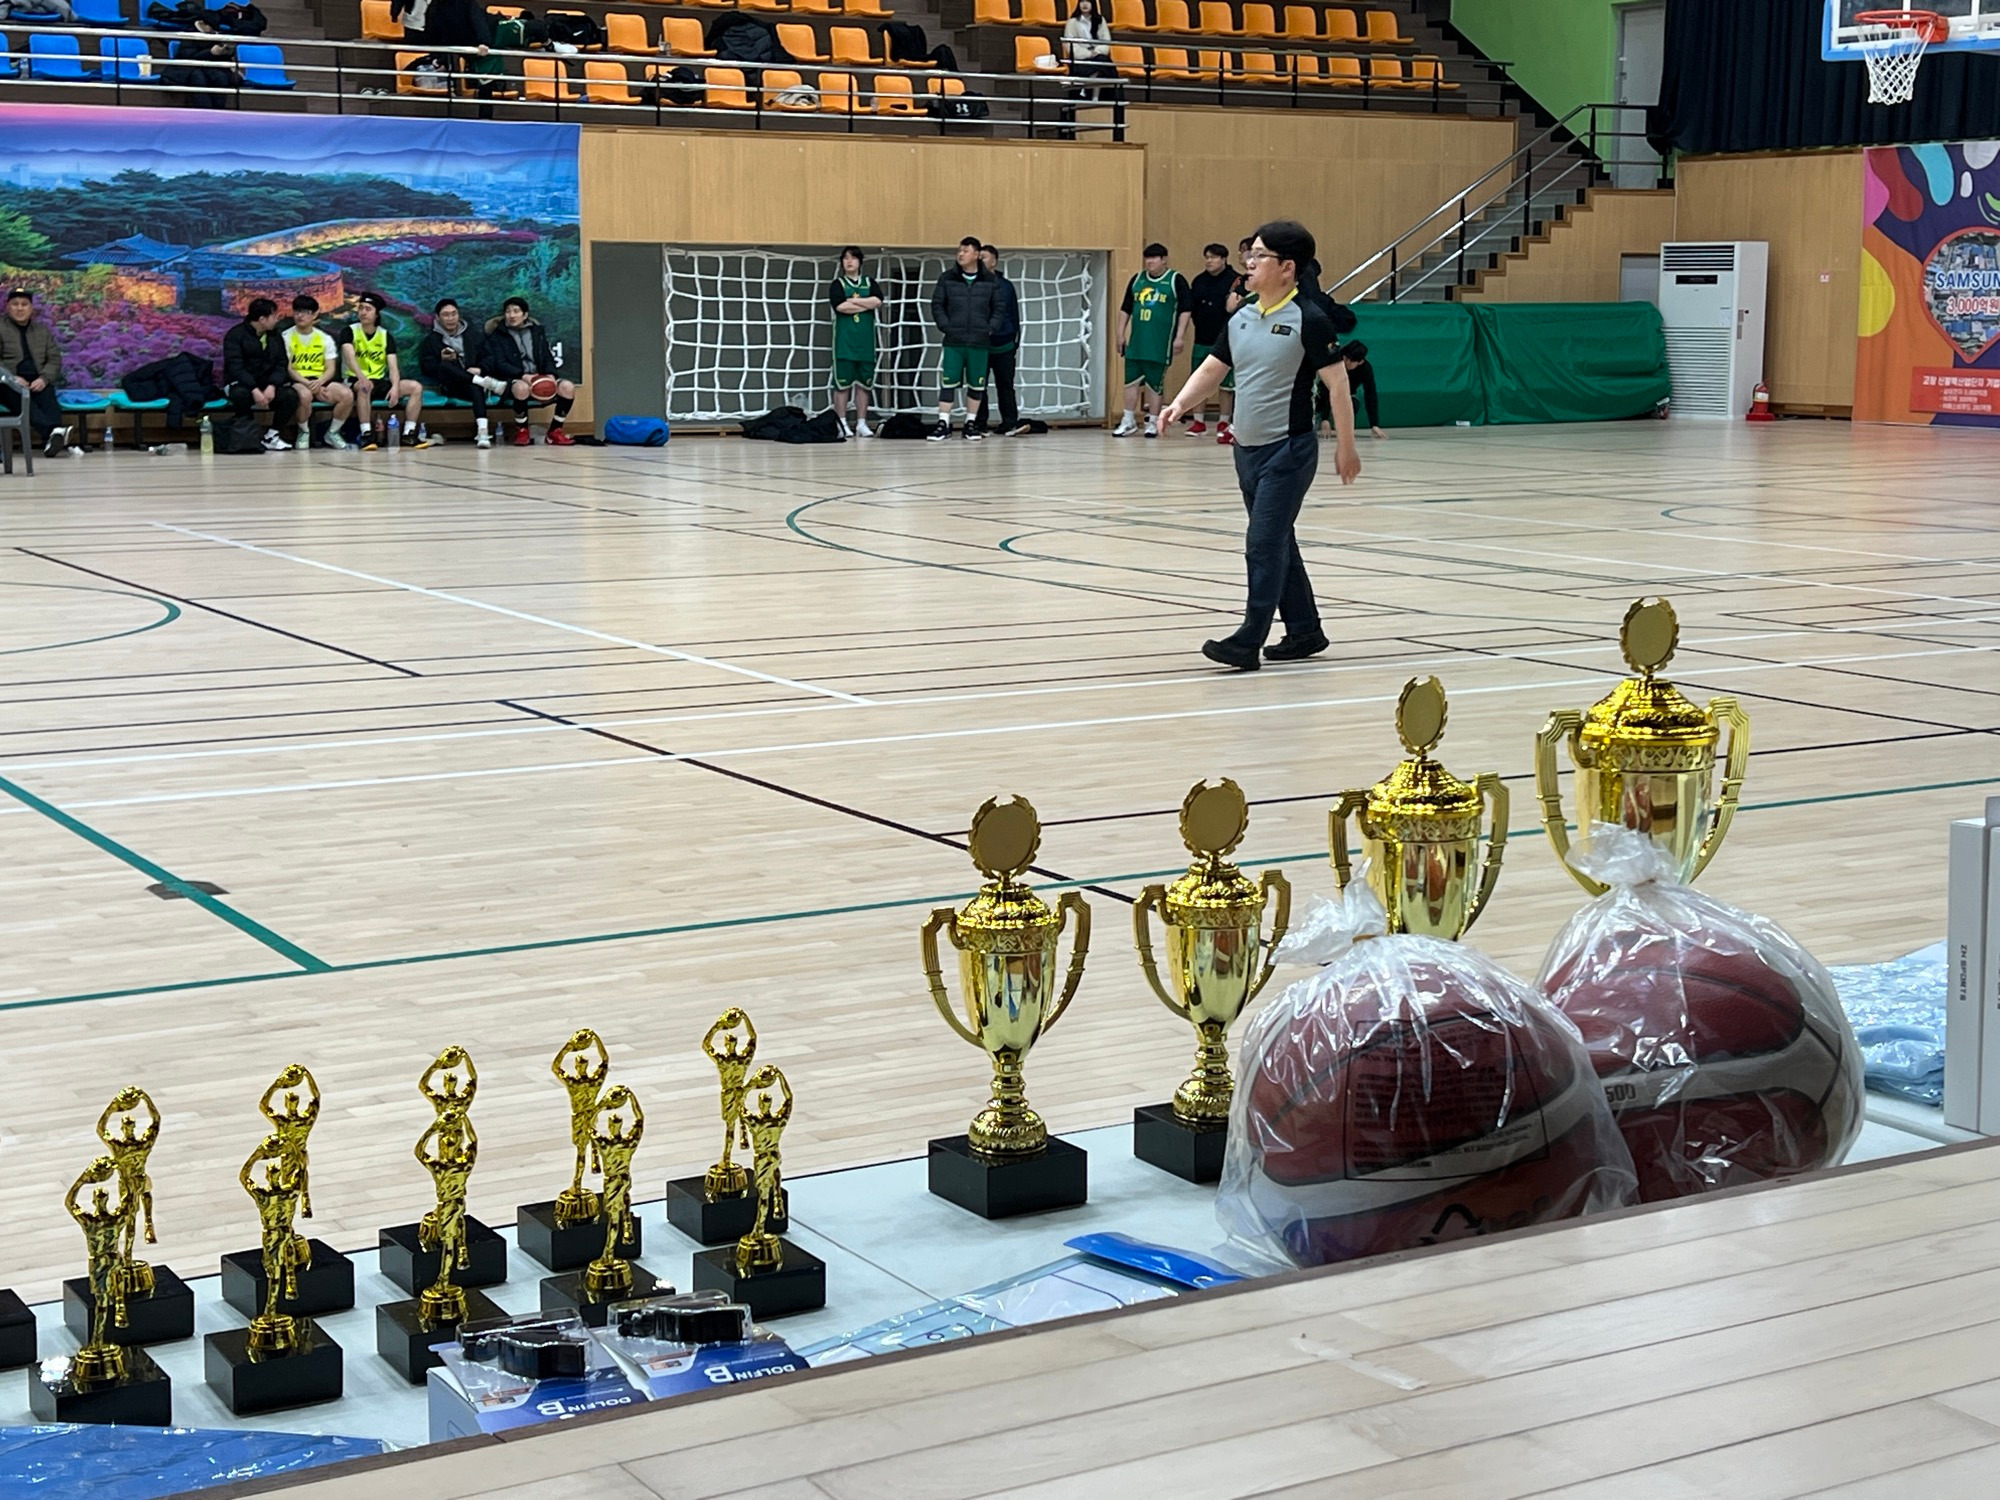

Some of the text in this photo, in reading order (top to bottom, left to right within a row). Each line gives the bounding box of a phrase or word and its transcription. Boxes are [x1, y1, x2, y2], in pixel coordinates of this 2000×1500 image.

[1140, 308, 1152, 321] 10
[1947, 297, 1999, 314] 3,000억원
[704, 1364, 796, 1384] DOLFIN B
[536, 1396, 632, 1416] DOLFIN B
